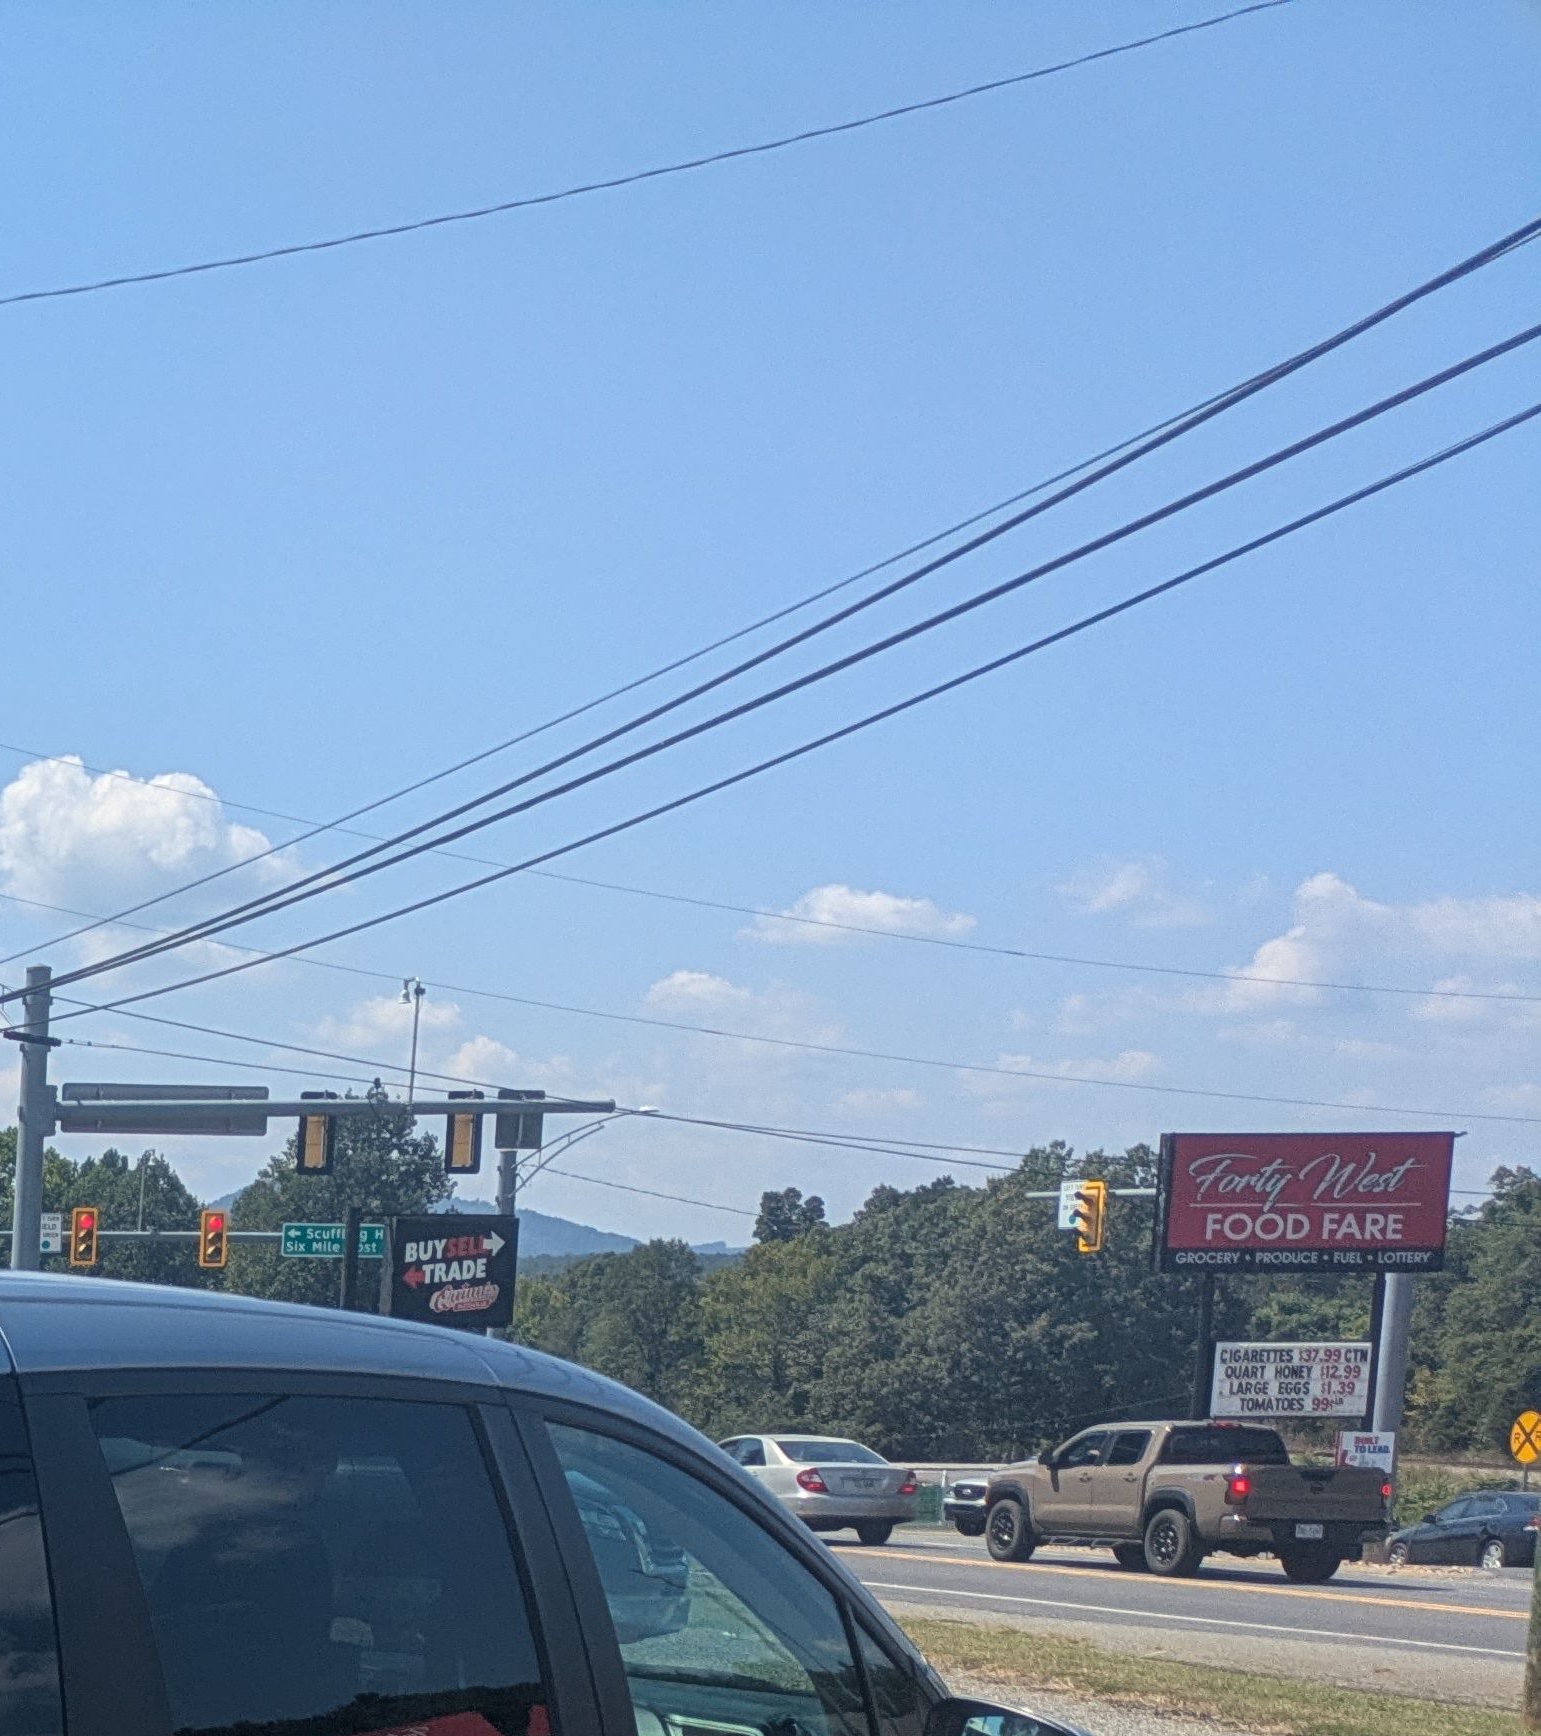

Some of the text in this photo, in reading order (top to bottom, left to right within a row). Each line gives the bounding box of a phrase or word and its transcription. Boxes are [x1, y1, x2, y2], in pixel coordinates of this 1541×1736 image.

[1188, 1152, 1430, 1212] Forty West
[1205, 1213, 1404, 1241] FOOD FARE
[306, 1228, 368, 1242] Scufflg
[286, 1241, 306, 1253] Six
[312, 1241, 341, 1253] Mile
[404, 1235, 486, 1263] BUY SELL
[1175, 1252, 1431, 1265] GROCERY PRODUCE FUEL LOTTERY
[422, 1258, 487, 1284] TRADE
[1220, 1349, 1367, 1364] CIGARETTES $37.99 CTN
[1225, 1365, 1361, 1379] QUART HONEY $12.99
[1229, 1381, 1356, 1396] LARGE EGGS $1.39
[1239, 1397, 1305, 1412] TOMATOES
[1354, 1445, 1367, 1453] TO
